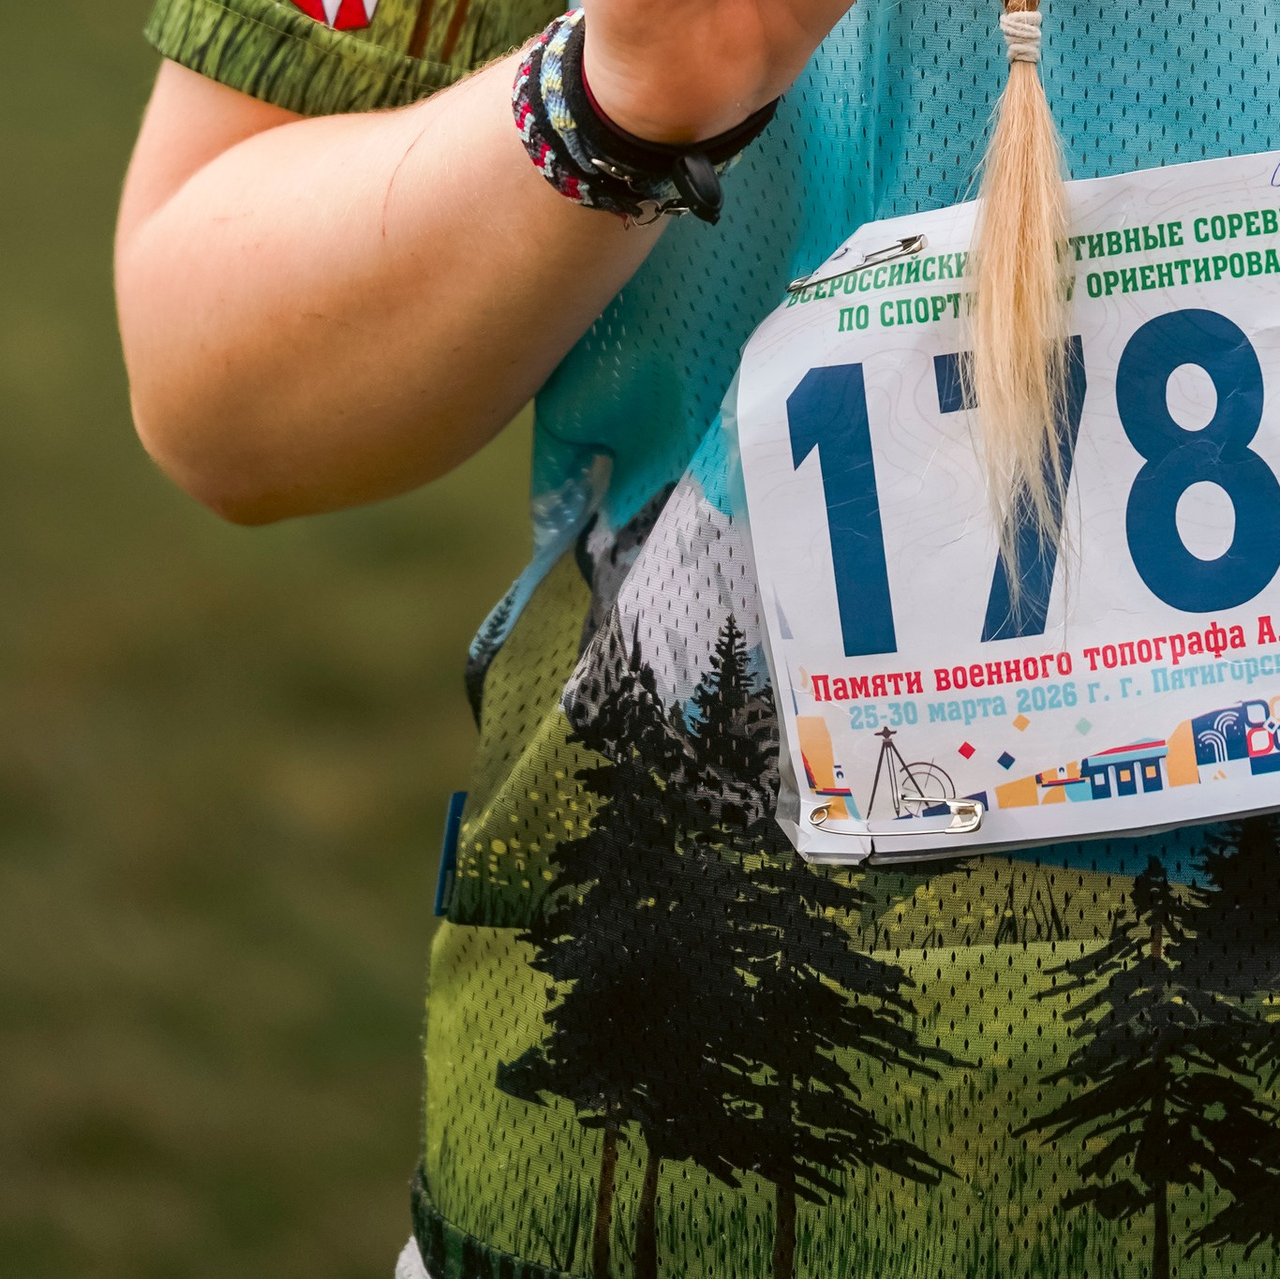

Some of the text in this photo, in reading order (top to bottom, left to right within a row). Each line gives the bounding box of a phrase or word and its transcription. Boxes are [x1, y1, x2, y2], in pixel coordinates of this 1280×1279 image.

[786, 252, 969, 309] ВСЕРОССИЙСКИ
[1068, 221, 1184, 261] ТИВНЫЕ
[838, 304, 869, 332] ПО
[880, 293, 964, 327] СПОРТ
[811, 671, 924, 701] Памяти
[934, 651, 1072, 691] военного
[1083, 621, 1246, 676] топографа
[850, 701, 918, 730] 25-30
[928, 695, 1007, 725] марта
[1015, 681, 1077, 713] 2026
[1087, 681, 1111, 703] г.
[1119, 677, 1143, 699] г.
